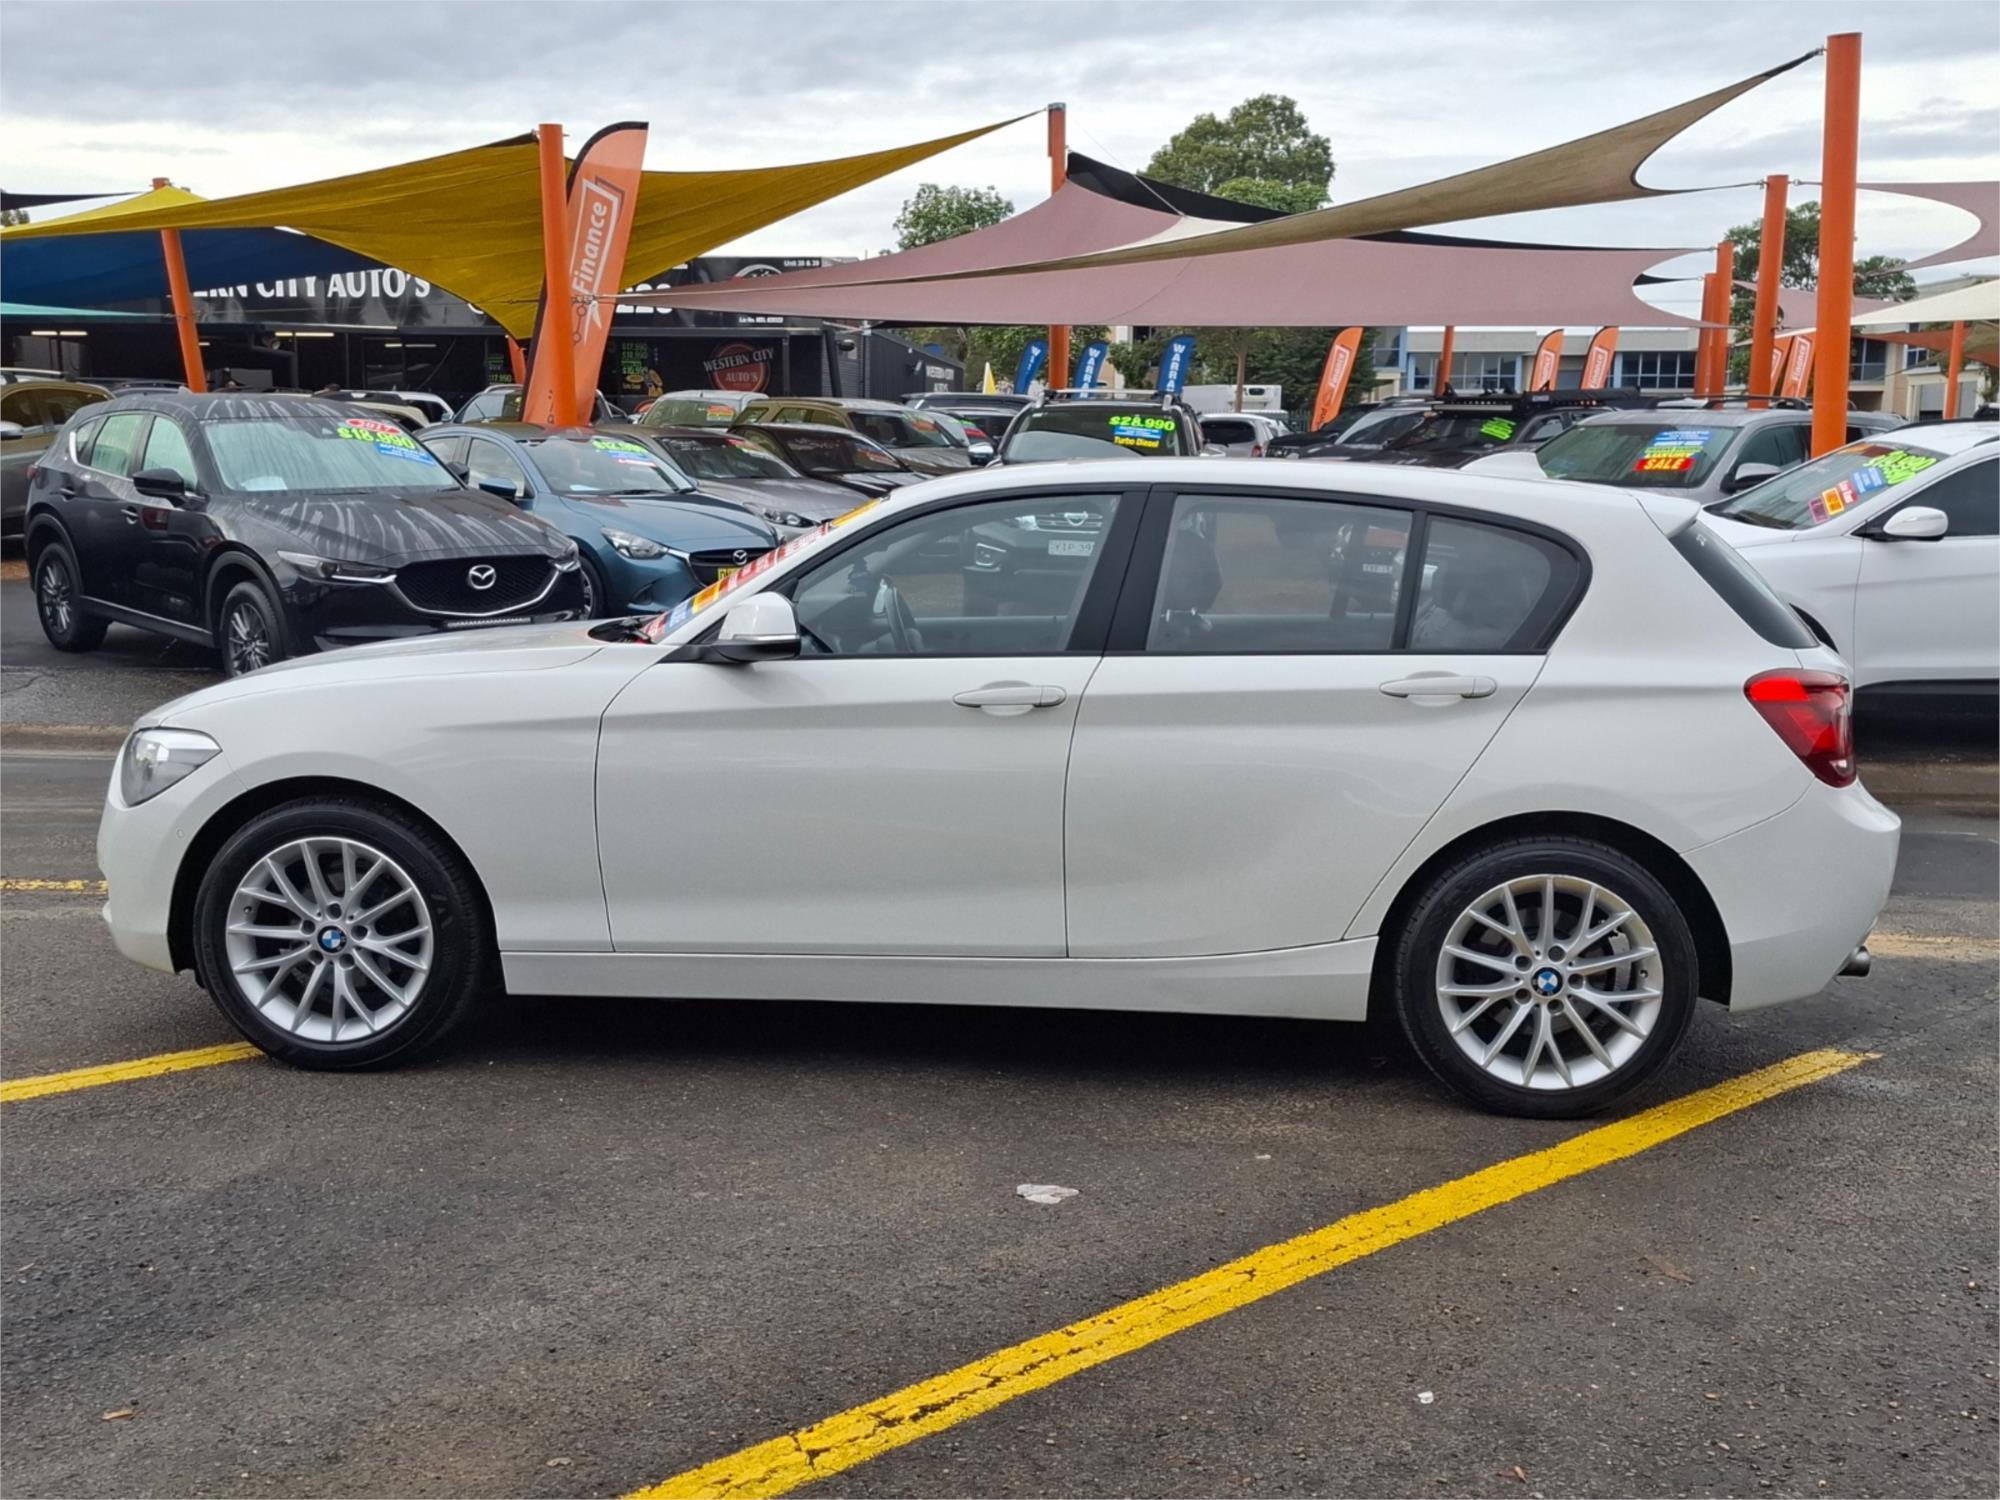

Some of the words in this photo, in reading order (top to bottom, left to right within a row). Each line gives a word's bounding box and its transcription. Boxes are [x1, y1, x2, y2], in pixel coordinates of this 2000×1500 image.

[571, 202, 608, 297] Finance
[256, 275, 318, 298] CITY
[327, 268, 431, 298] AUTO'S
[703, 355, 750, 373] WESTERN
[753, 348, 774, 362] CITY
[725, 371, 759, 383] AUTO'S
[1643, 457, 1686, 470] SALE
